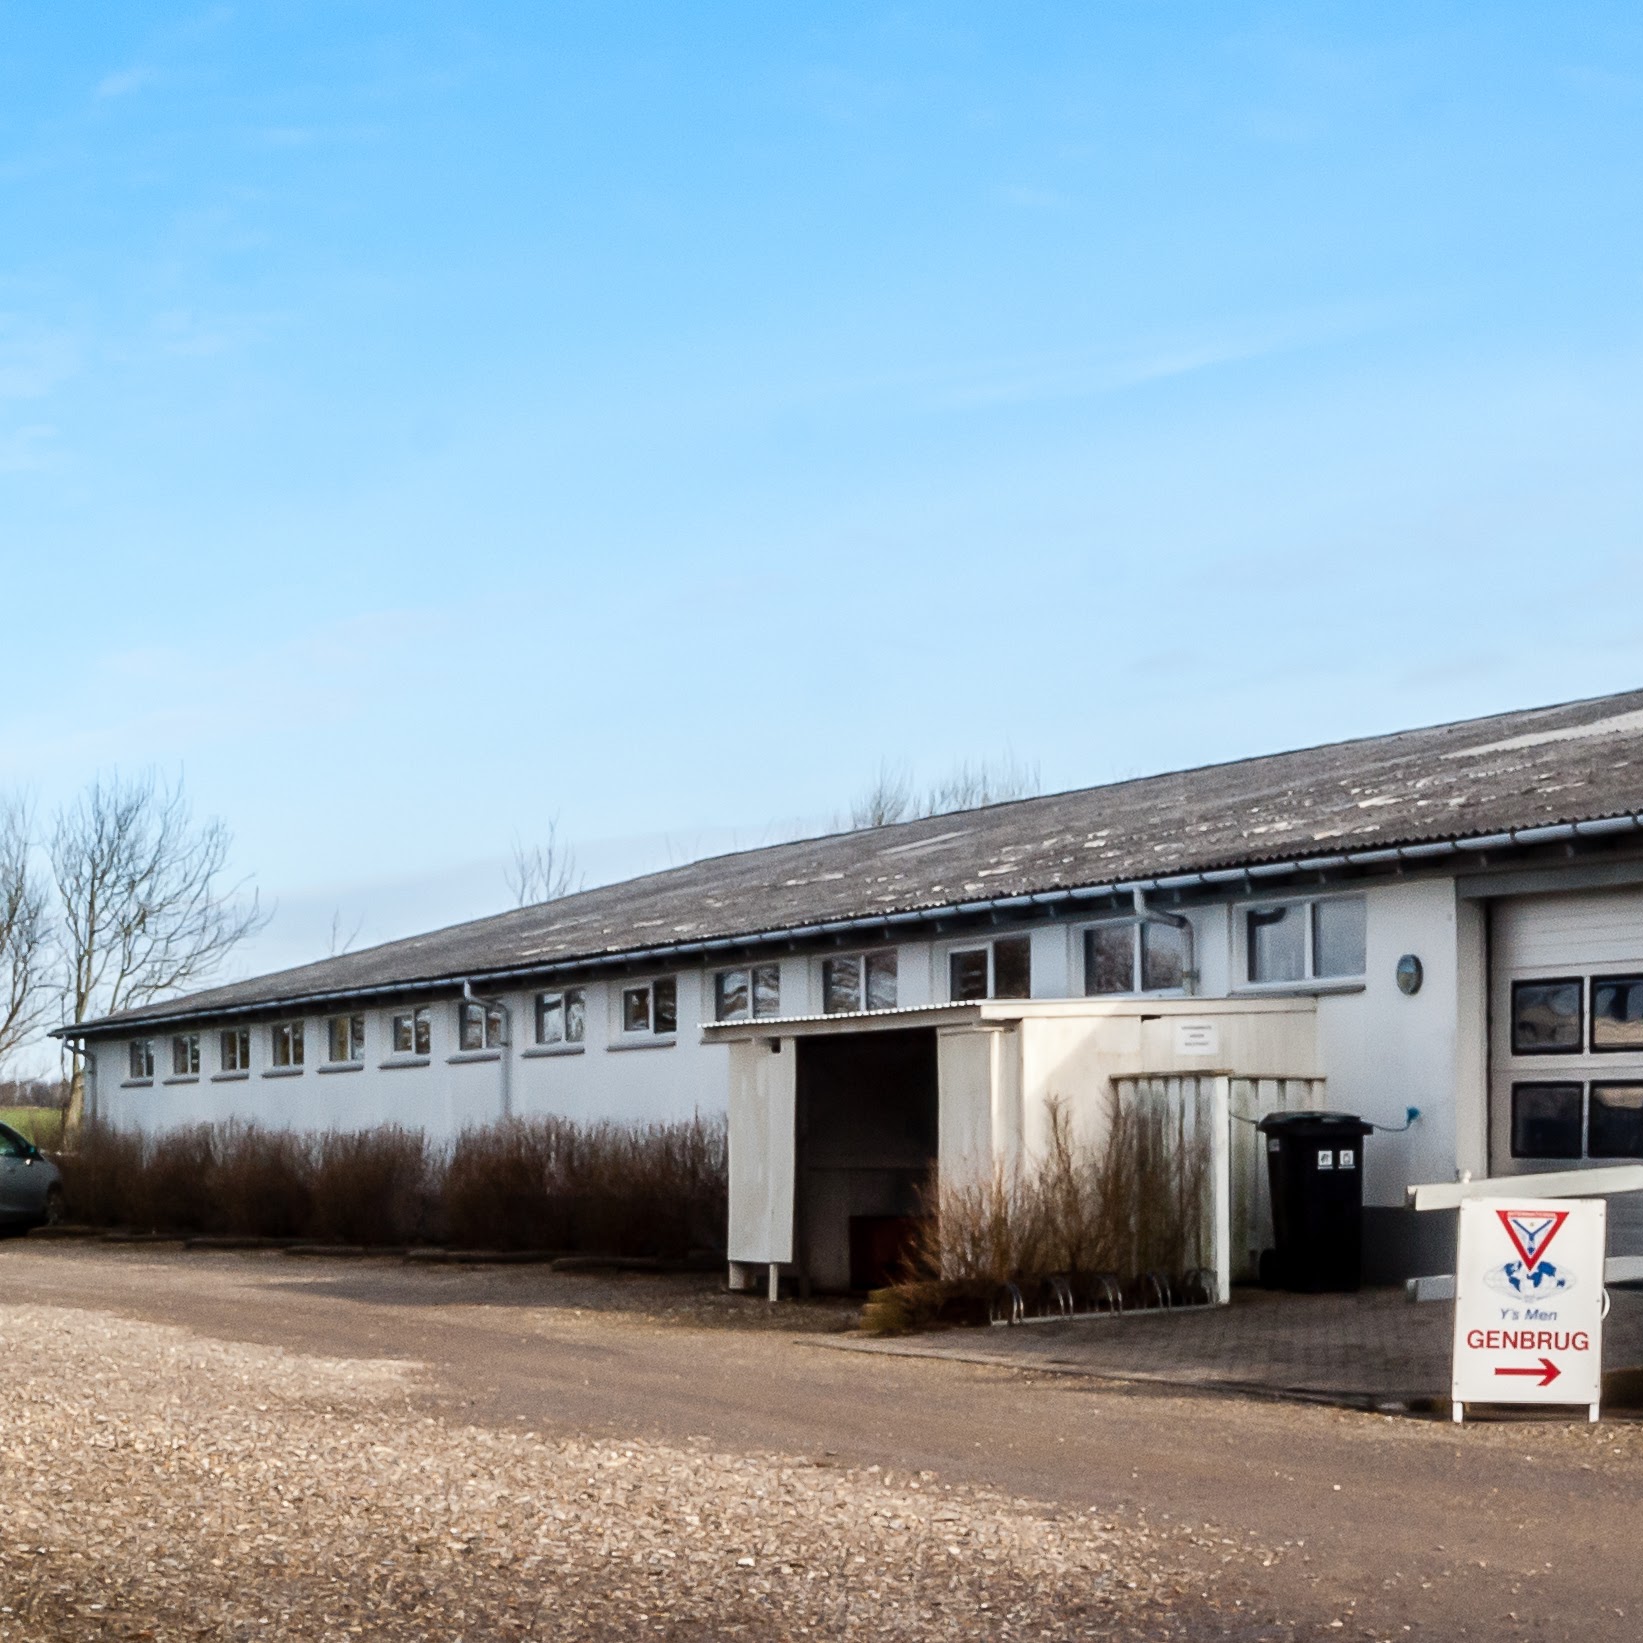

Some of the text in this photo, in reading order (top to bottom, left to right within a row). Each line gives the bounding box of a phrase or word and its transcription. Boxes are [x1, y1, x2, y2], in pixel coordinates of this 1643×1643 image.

[1501, 1308, 1558, 1321] Y's Men
[1467, 1329, 1590, 1351] GENBRUG
